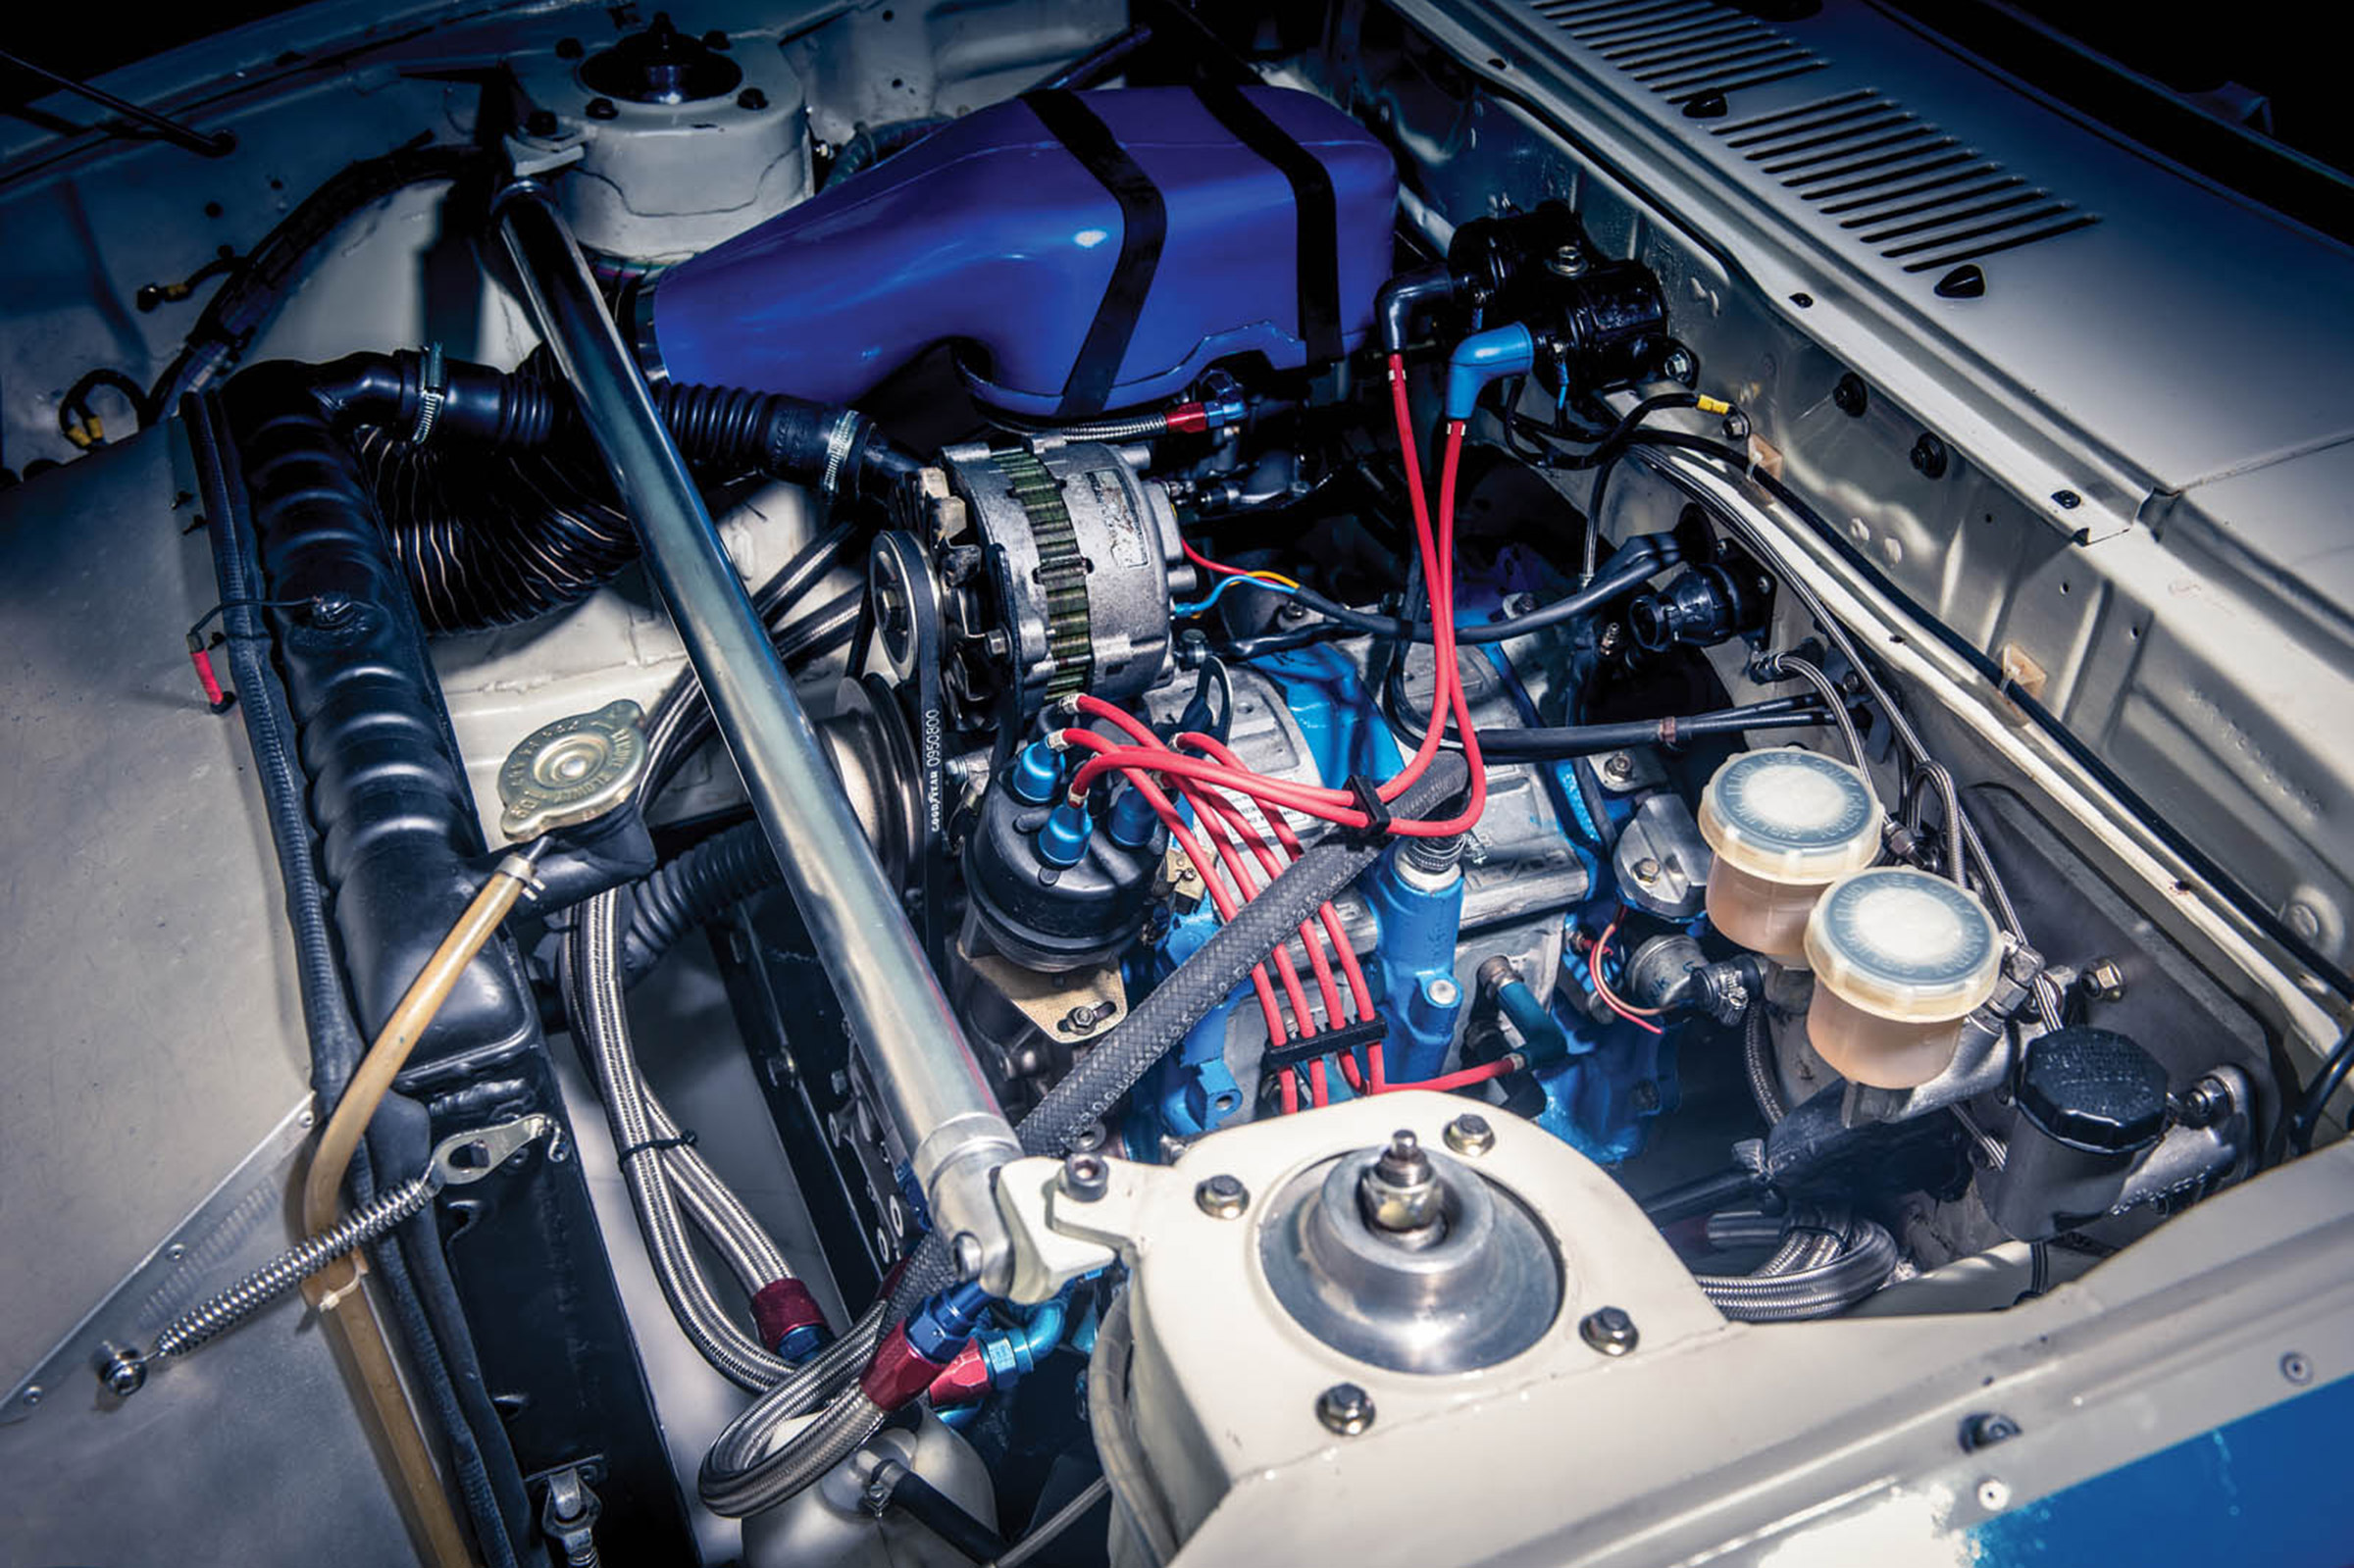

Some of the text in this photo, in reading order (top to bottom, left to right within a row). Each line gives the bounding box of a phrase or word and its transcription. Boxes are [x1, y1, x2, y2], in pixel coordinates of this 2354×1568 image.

[925, 709, 941, 833] GOODYEAR 0950800
[1763, 753, 1804, 767] USE
[1812, 759, 1859, 788] ONLY
